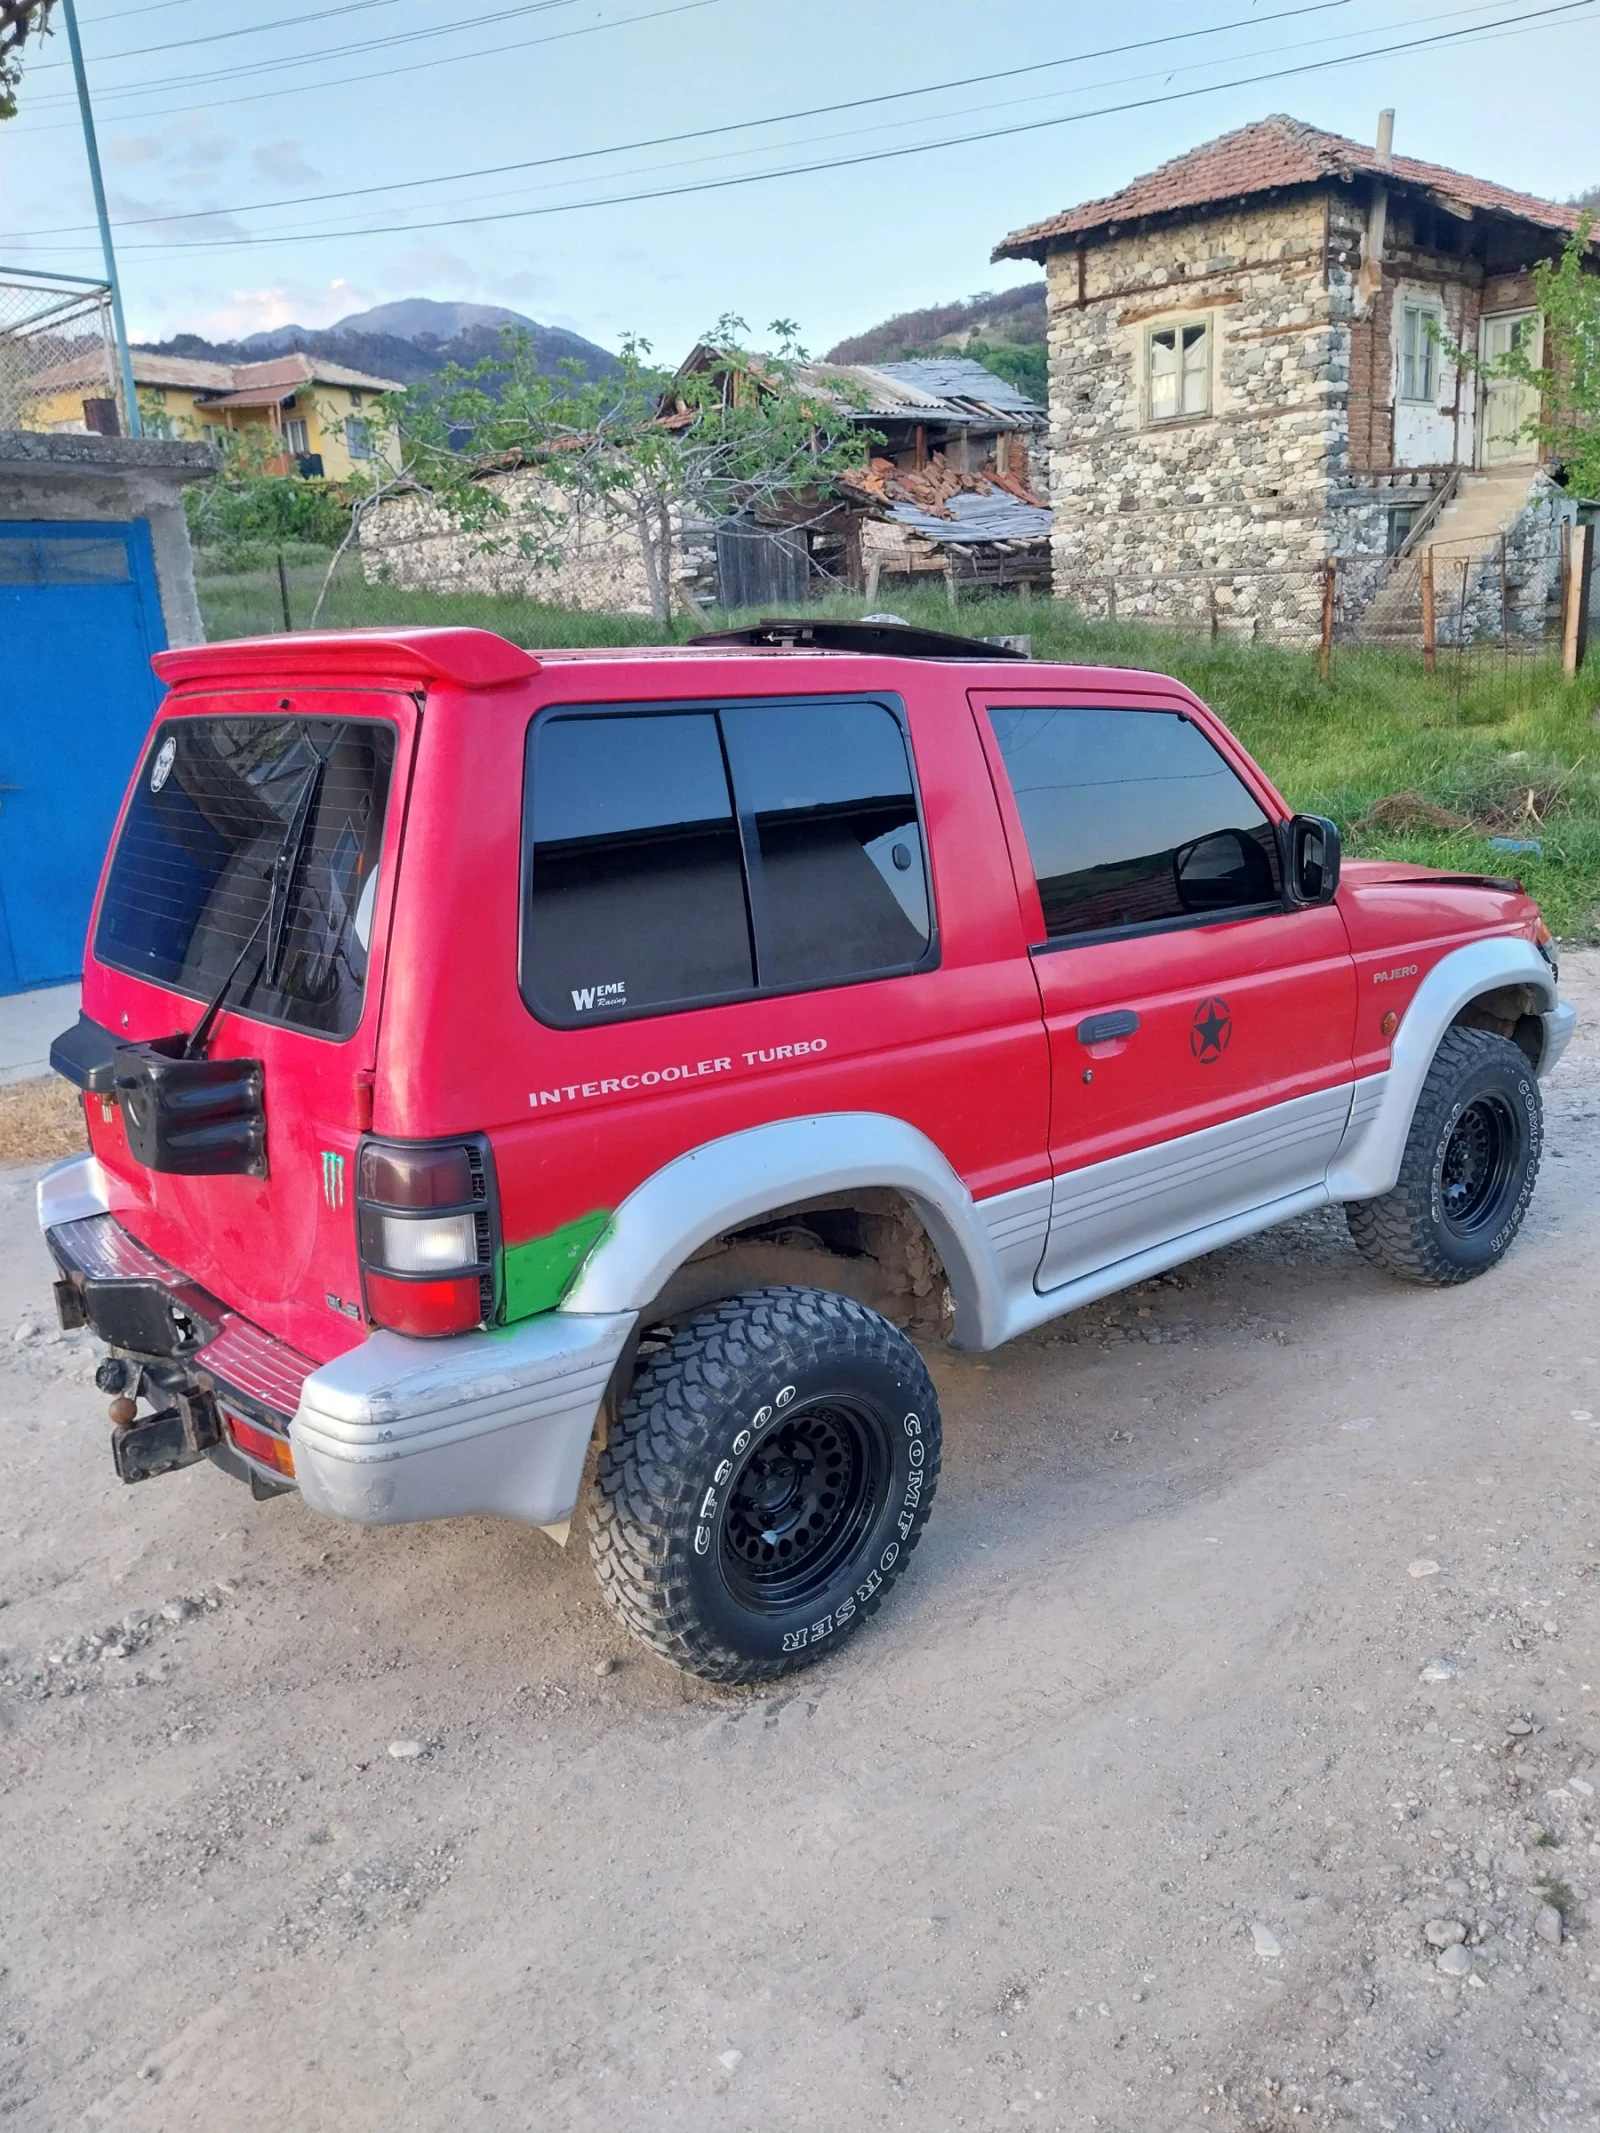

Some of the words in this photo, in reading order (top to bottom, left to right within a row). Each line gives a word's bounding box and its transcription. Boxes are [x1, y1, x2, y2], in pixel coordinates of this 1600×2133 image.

[571, 981, 626, 1011] WEME
[597, 997, 627, 1008] Racing
[1373, 964, 1418, 984] PAJERO
[528, 1056, 732, 1107] INTERCOOLER
[741, 1037, 828, 1066] TURBO
[1490, 1079, 1539, 1252] COMFORSER
[694, 1384, 797, 1555] CF3000
[781, 1411, 926, 1652] COMFORSER
